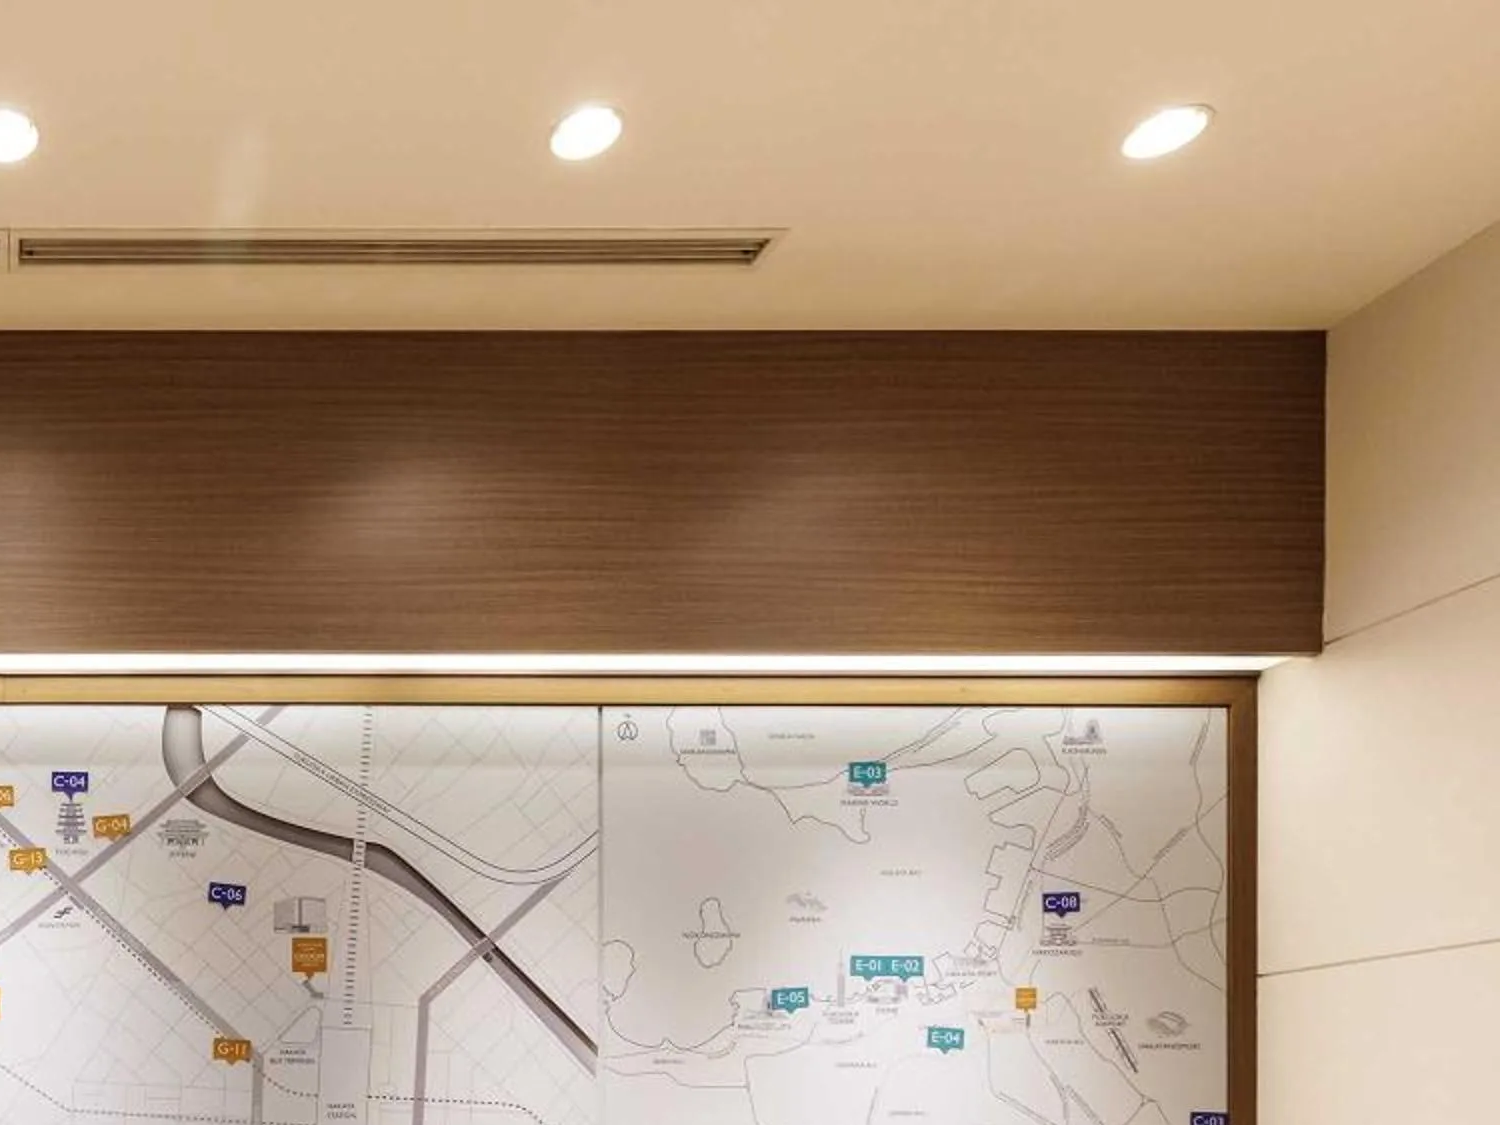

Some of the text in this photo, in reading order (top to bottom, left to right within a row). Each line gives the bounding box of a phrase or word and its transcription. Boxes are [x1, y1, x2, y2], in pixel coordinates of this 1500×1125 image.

[854, 766, 881, 778] E-03
[54, 776, 88, 788] C-04
[212, 888, 242, 901] C-06
[1045, 897, 1077, 908] C-08
[855, 960, 919, 971] E-01 E-02
[777, 992, 805, 1004] E-05
[931, 1032, 961, 1044] E-04
[217, 1043, 247, 1056] G-11
